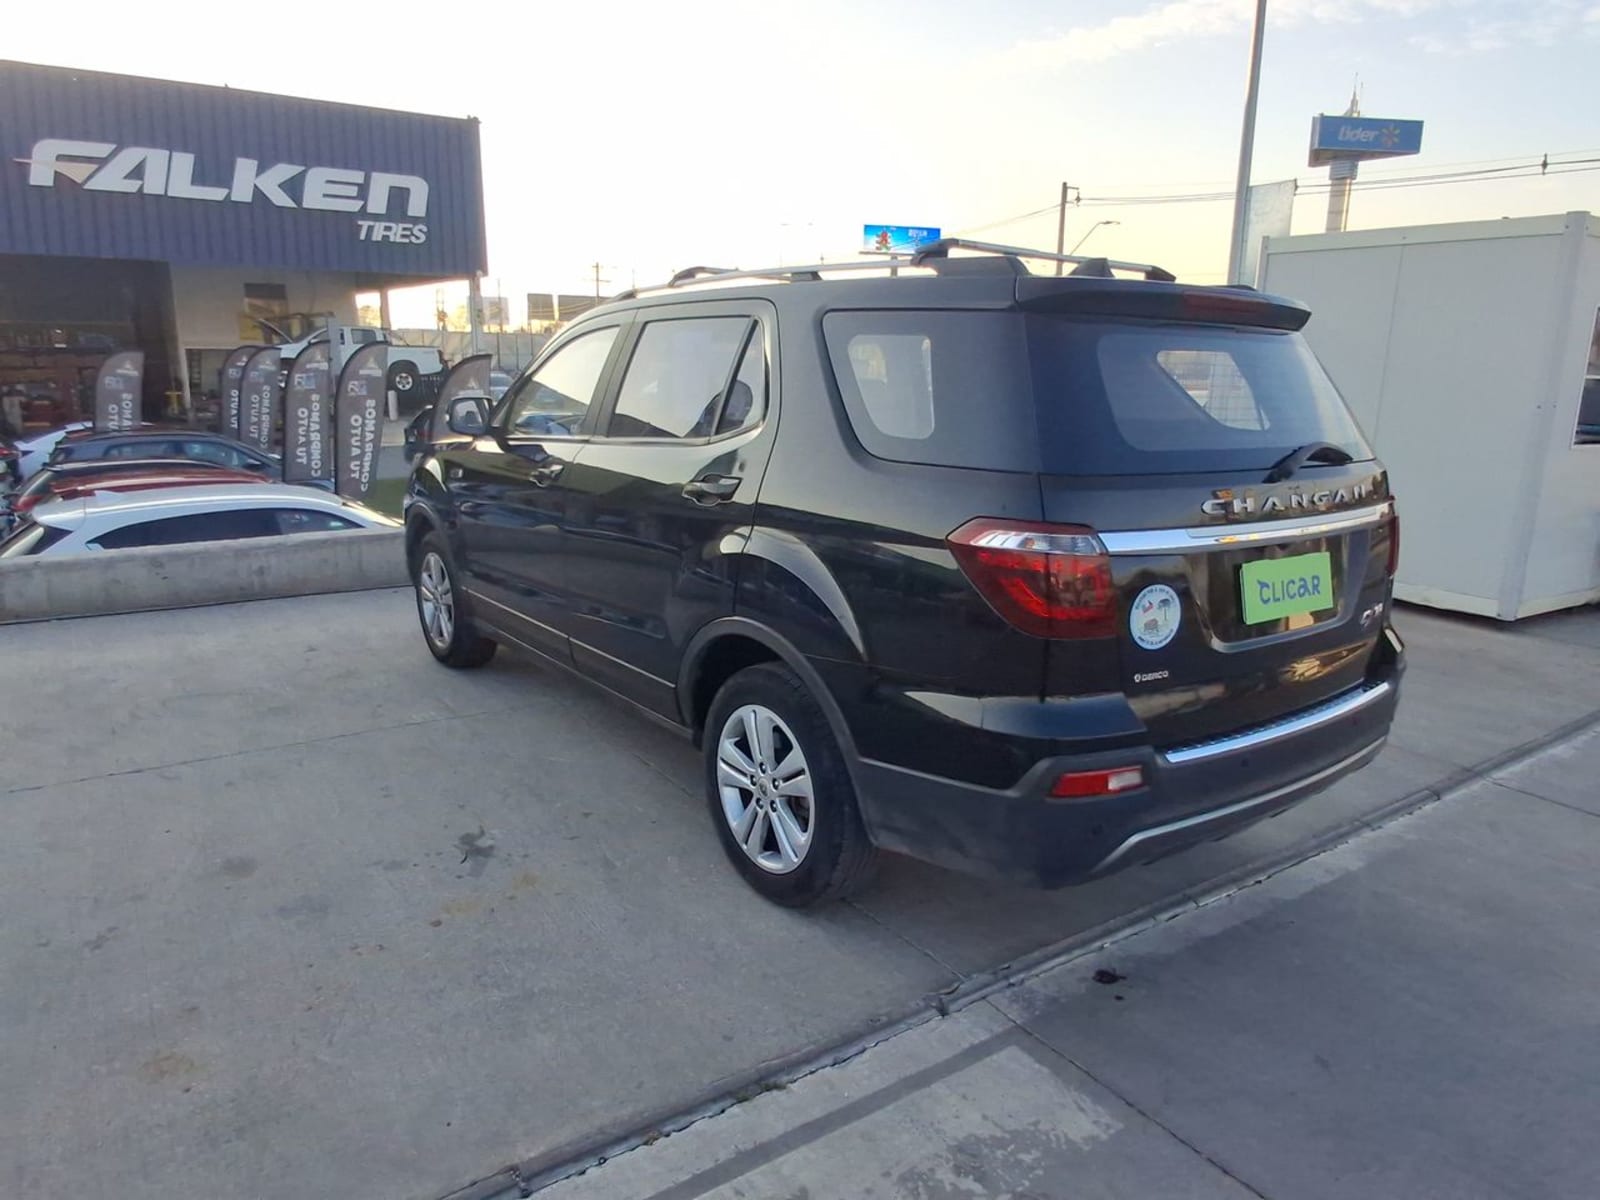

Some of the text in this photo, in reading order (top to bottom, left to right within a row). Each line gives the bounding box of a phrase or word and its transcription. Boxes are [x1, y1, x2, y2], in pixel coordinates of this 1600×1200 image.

[29, 138, 430, 217] FALKEN
[357, 220, 429, 245] TIRES
[1201, 484, 1367, 515] CHANGAN
[1142, 670, 1169, 681] DERCO
